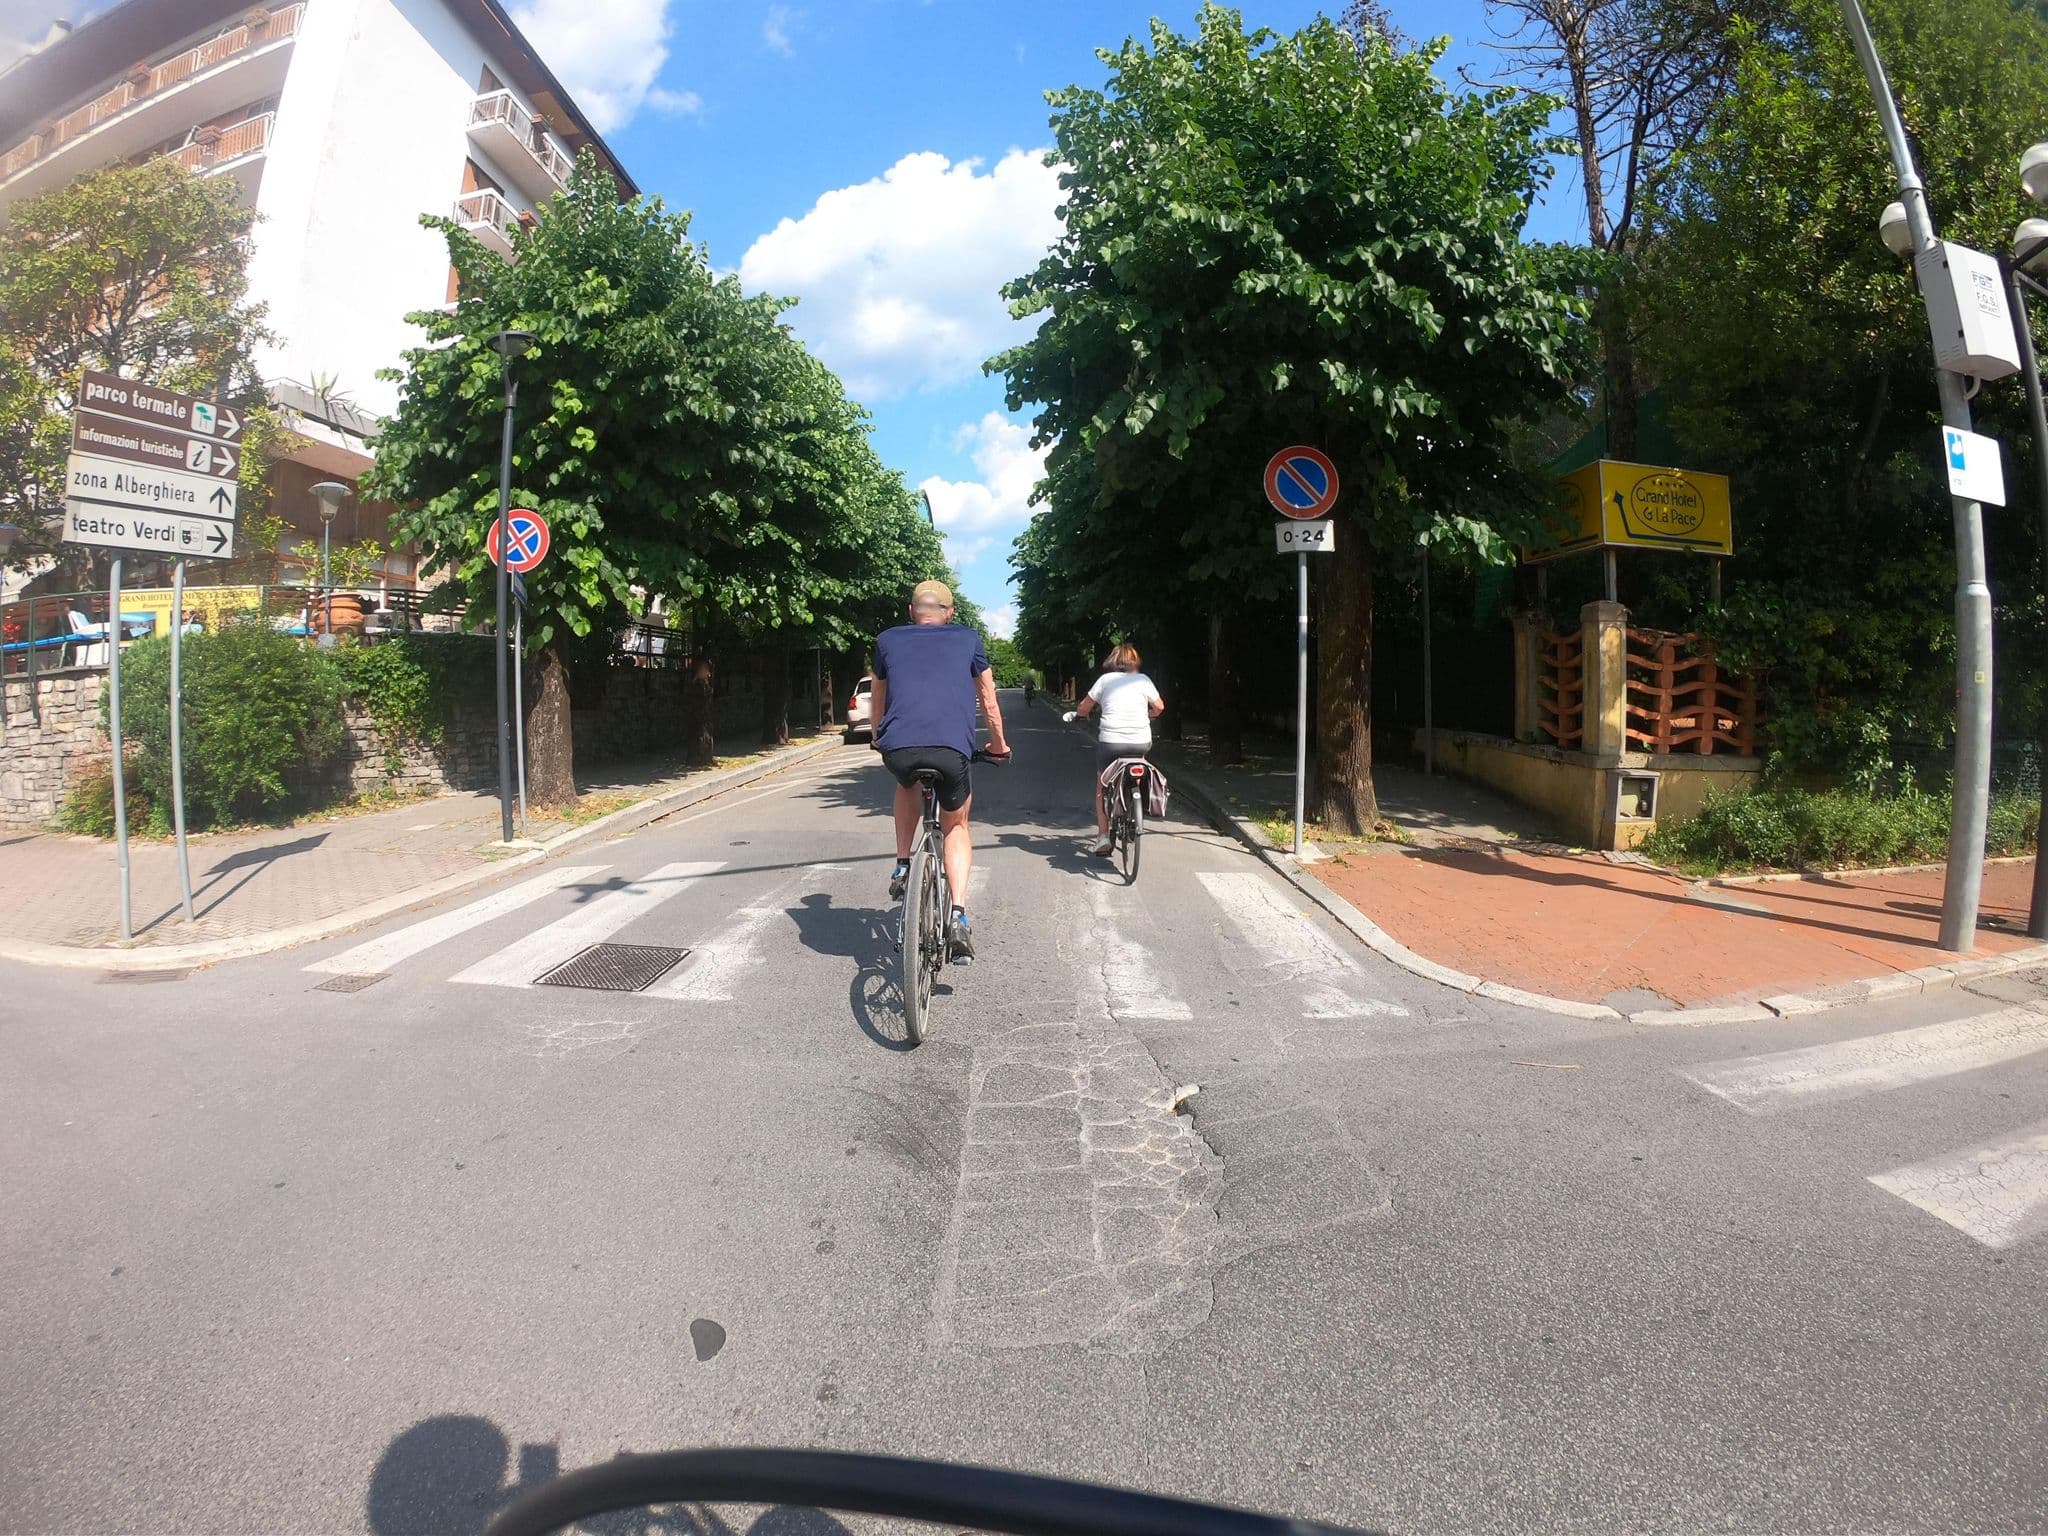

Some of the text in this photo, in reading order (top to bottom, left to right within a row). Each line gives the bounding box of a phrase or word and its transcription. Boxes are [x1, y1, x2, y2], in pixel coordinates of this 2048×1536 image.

[86, 382, 187, 419] parco termale
[79, 426, 139, 450] informazioni
[141, 439, 184, 460] turistiche
[74, 472, 195, 503] zona Alberghiera
[1636, 487, 1696, 508] Grand Hotel
[72, 513, 175, 542] teatro Verdi
[1656, 507, 1669, 523] La
[1671, 509, 1696, 527] Pace
[1283, 530, 1325, 543] 0-24
[119, 594, 146, 602] GRAND
